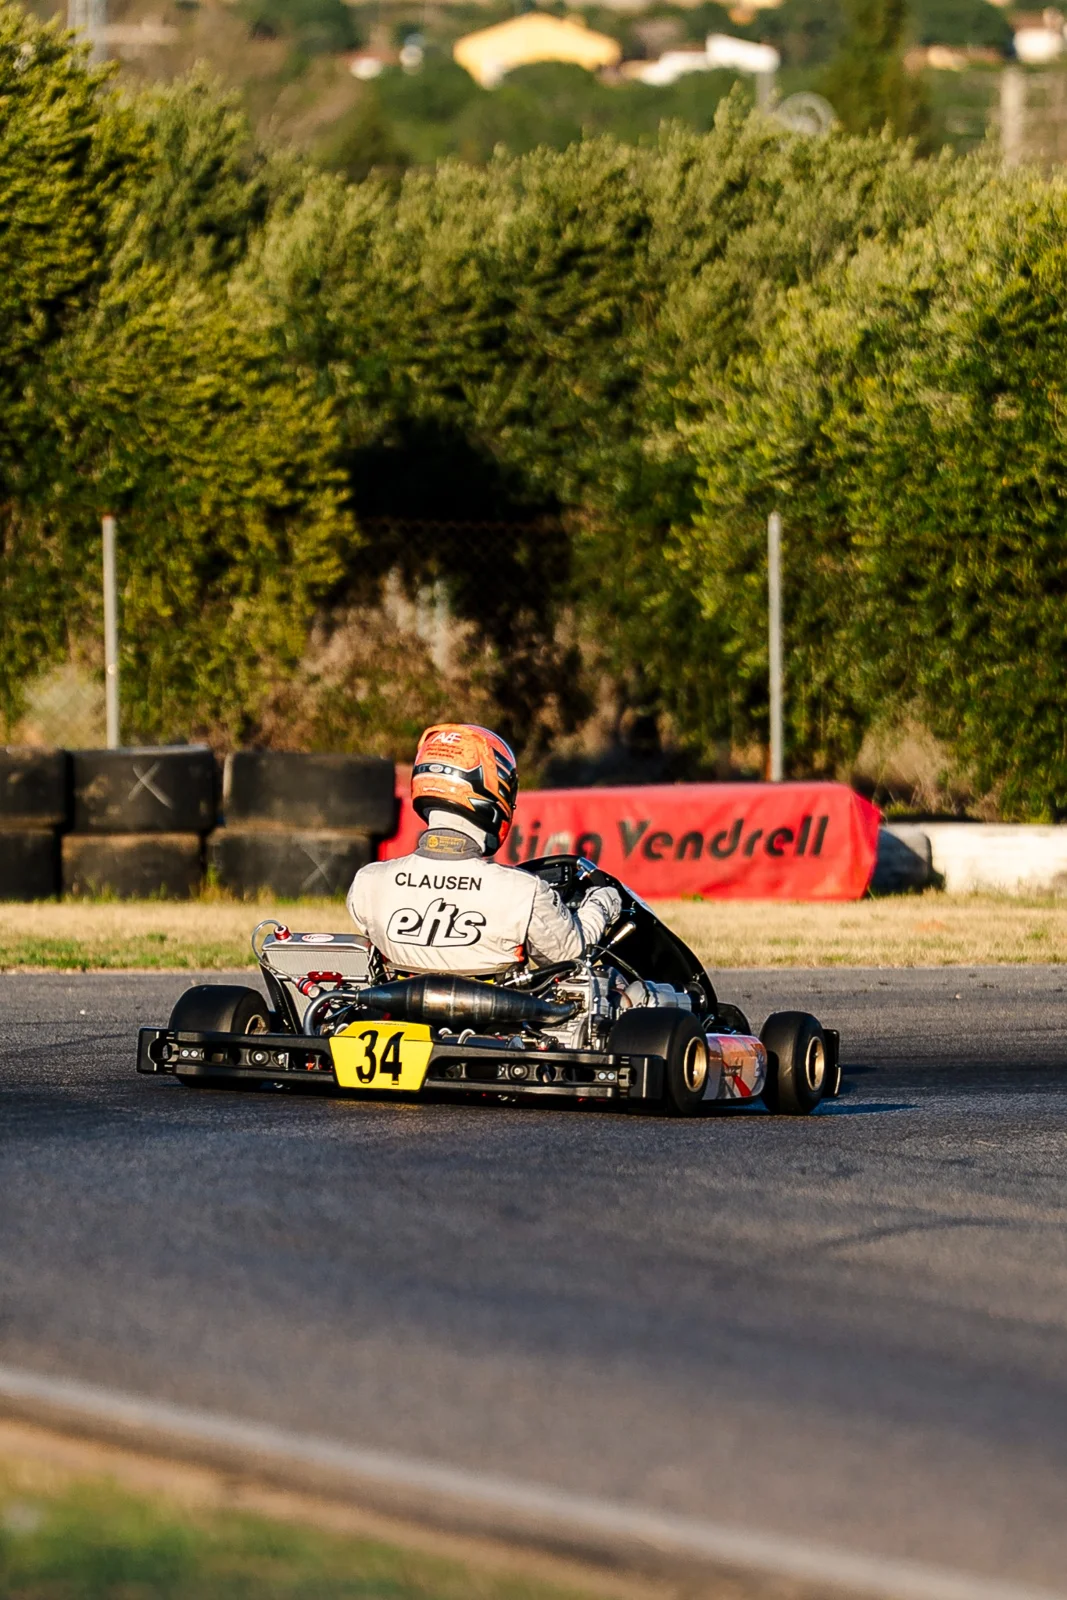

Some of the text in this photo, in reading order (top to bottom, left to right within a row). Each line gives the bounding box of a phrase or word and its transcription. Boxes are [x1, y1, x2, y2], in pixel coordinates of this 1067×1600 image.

[507, 814, 829, 866] ting Vendrell
[395, 872, 482, 891] CLAUSEN
[356, 1030, 405, 1085] 34
